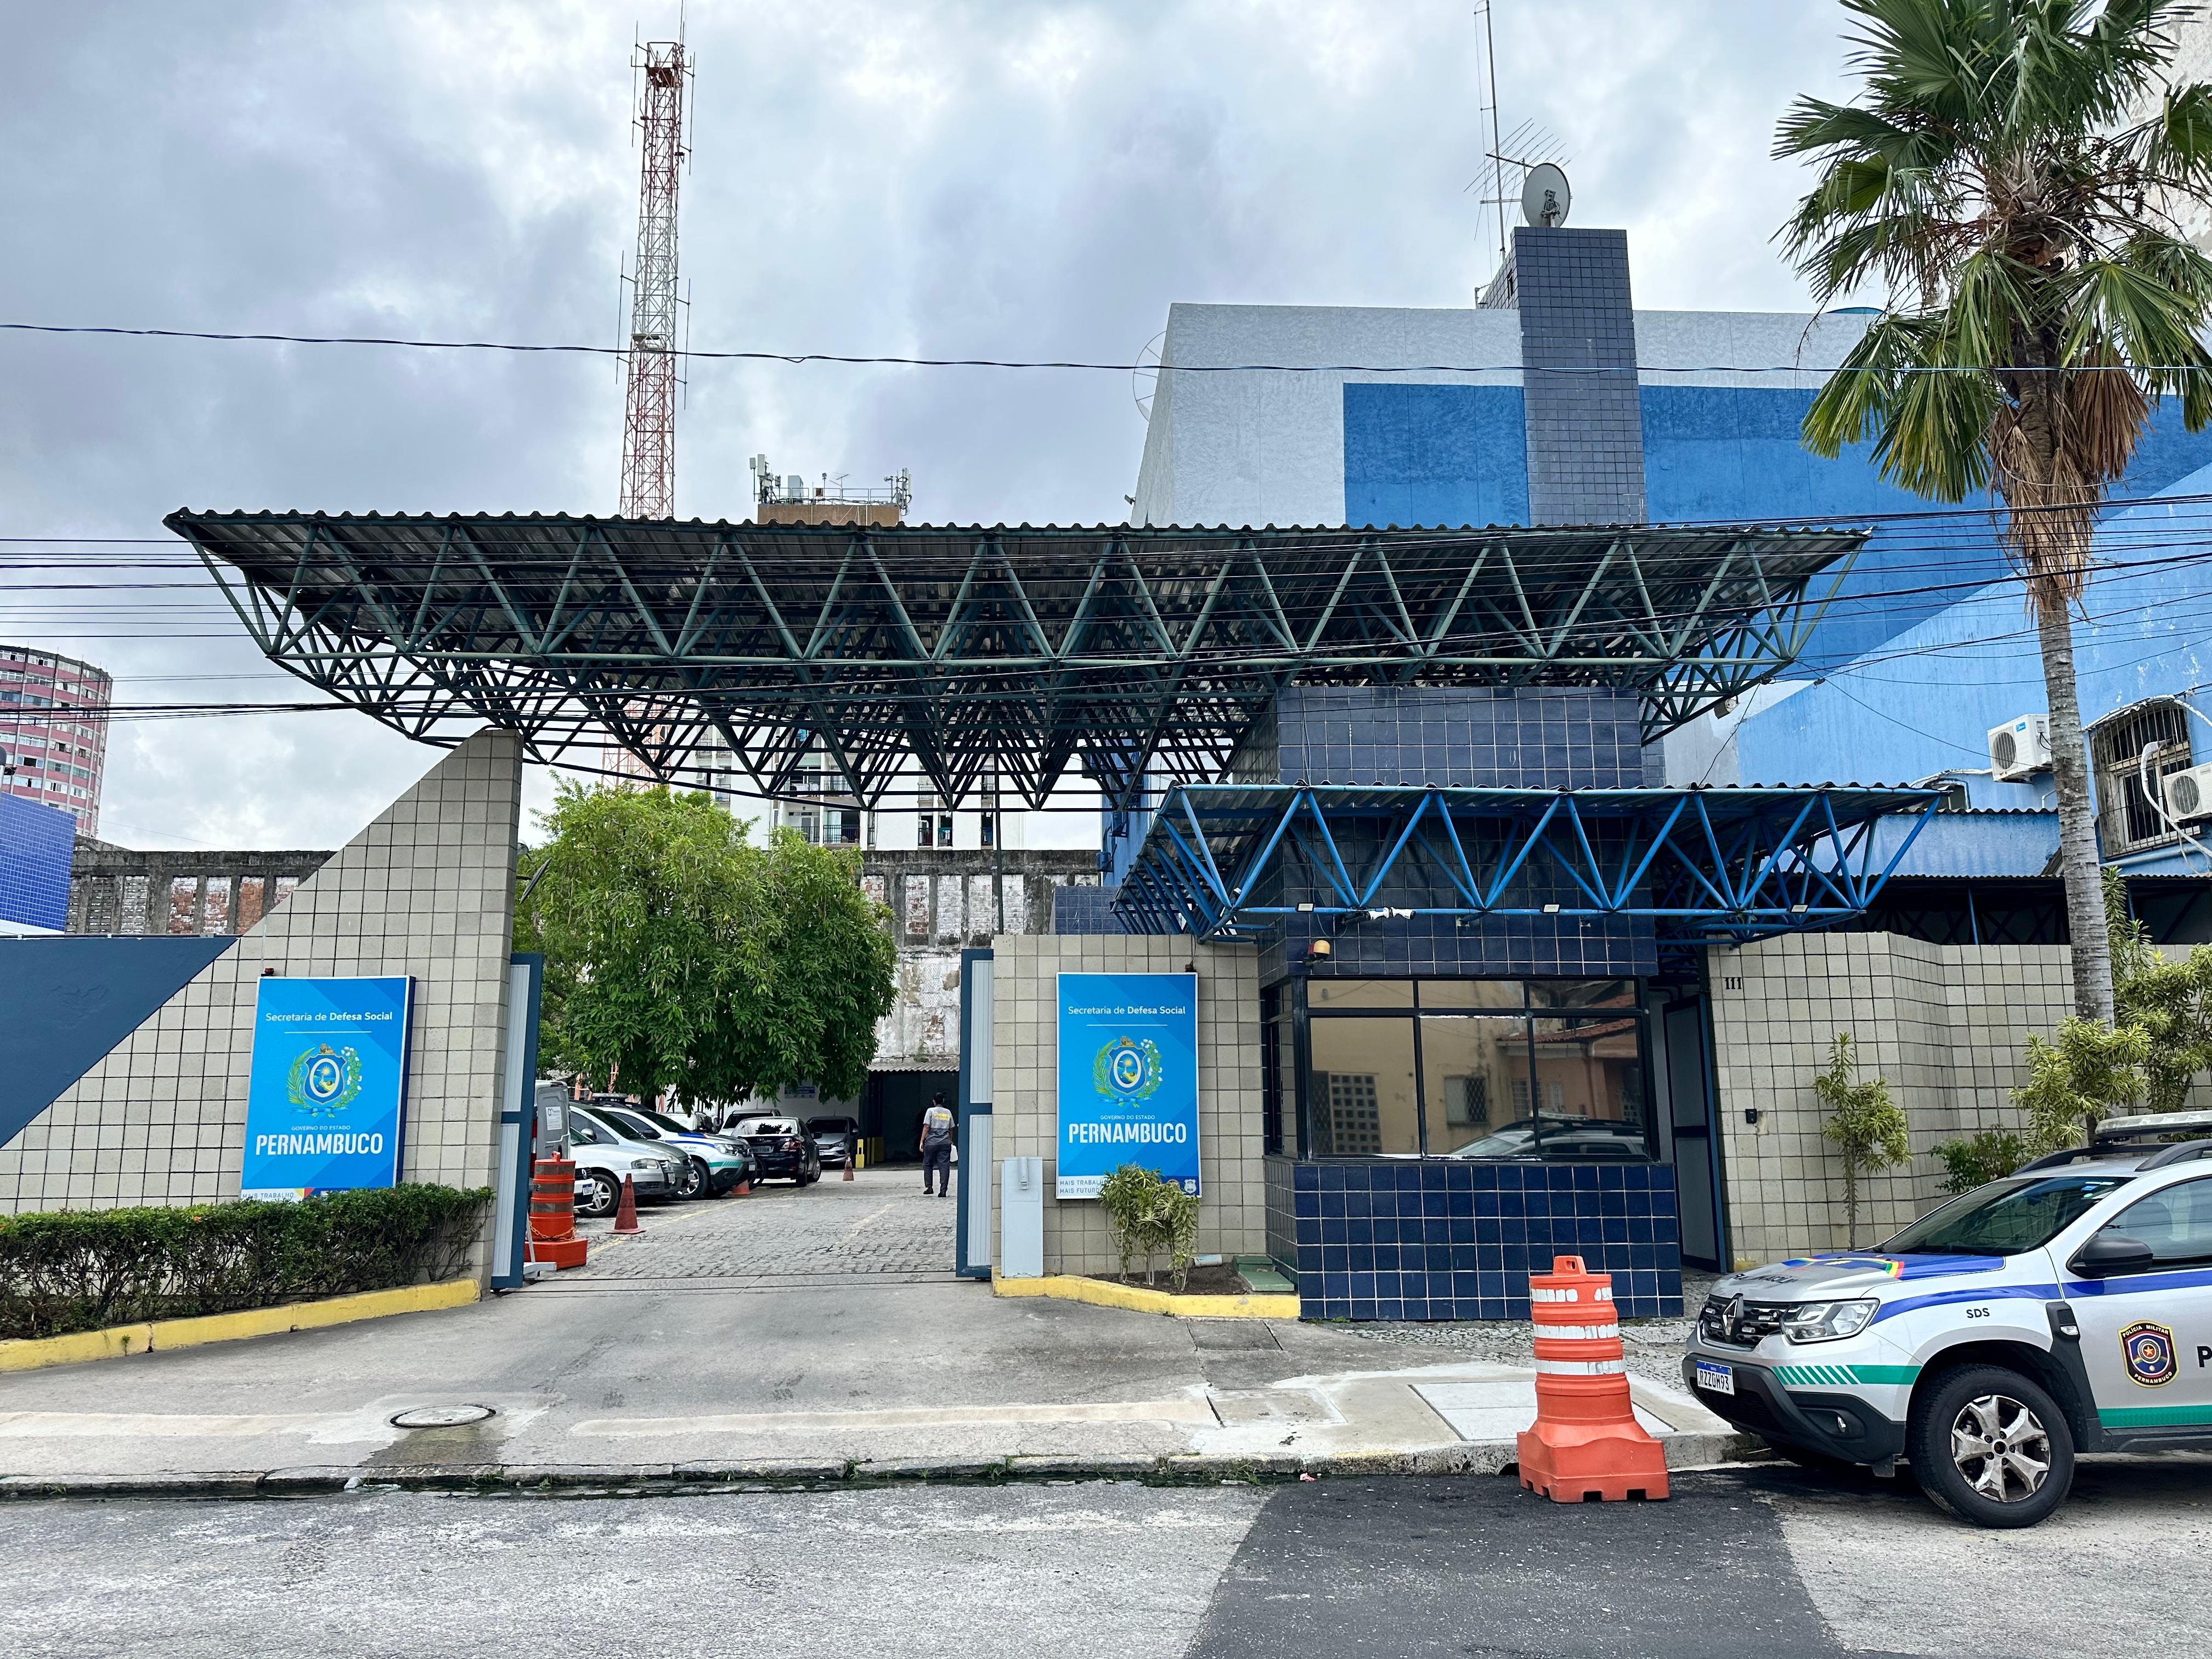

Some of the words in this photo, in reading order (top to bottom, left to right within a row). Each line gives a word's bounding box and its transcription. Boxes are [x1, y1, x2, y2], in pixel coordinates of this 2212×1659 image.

[266, 1013, 312, 1021] Secretaria
[315, 1012, 326, 1021] de
[330, 1012, 362, 1020] Defesa
[364, 1012, 392, 1020] Social
[1068, 1006, 1111, 1014] Secretaria
[1114, 1006, 1125, 1014] de
[1127, 1006, 1157, 1014] Defesa
[1159, 1006, 1186, 1014] Social
[1069, 1123, 1187, 1143] PERNAMBUCO
[256, 1133, 383, 1155] PERNAMBUCO
[1966, 1308, 1990, 1318] SDS
[2122, 1325, 2143, 1338] POLÍCIA
[2146, 1324, 2169, 1335] MILITAR
[2134, 1371, 2172, 1384] PERNAMBUCO
